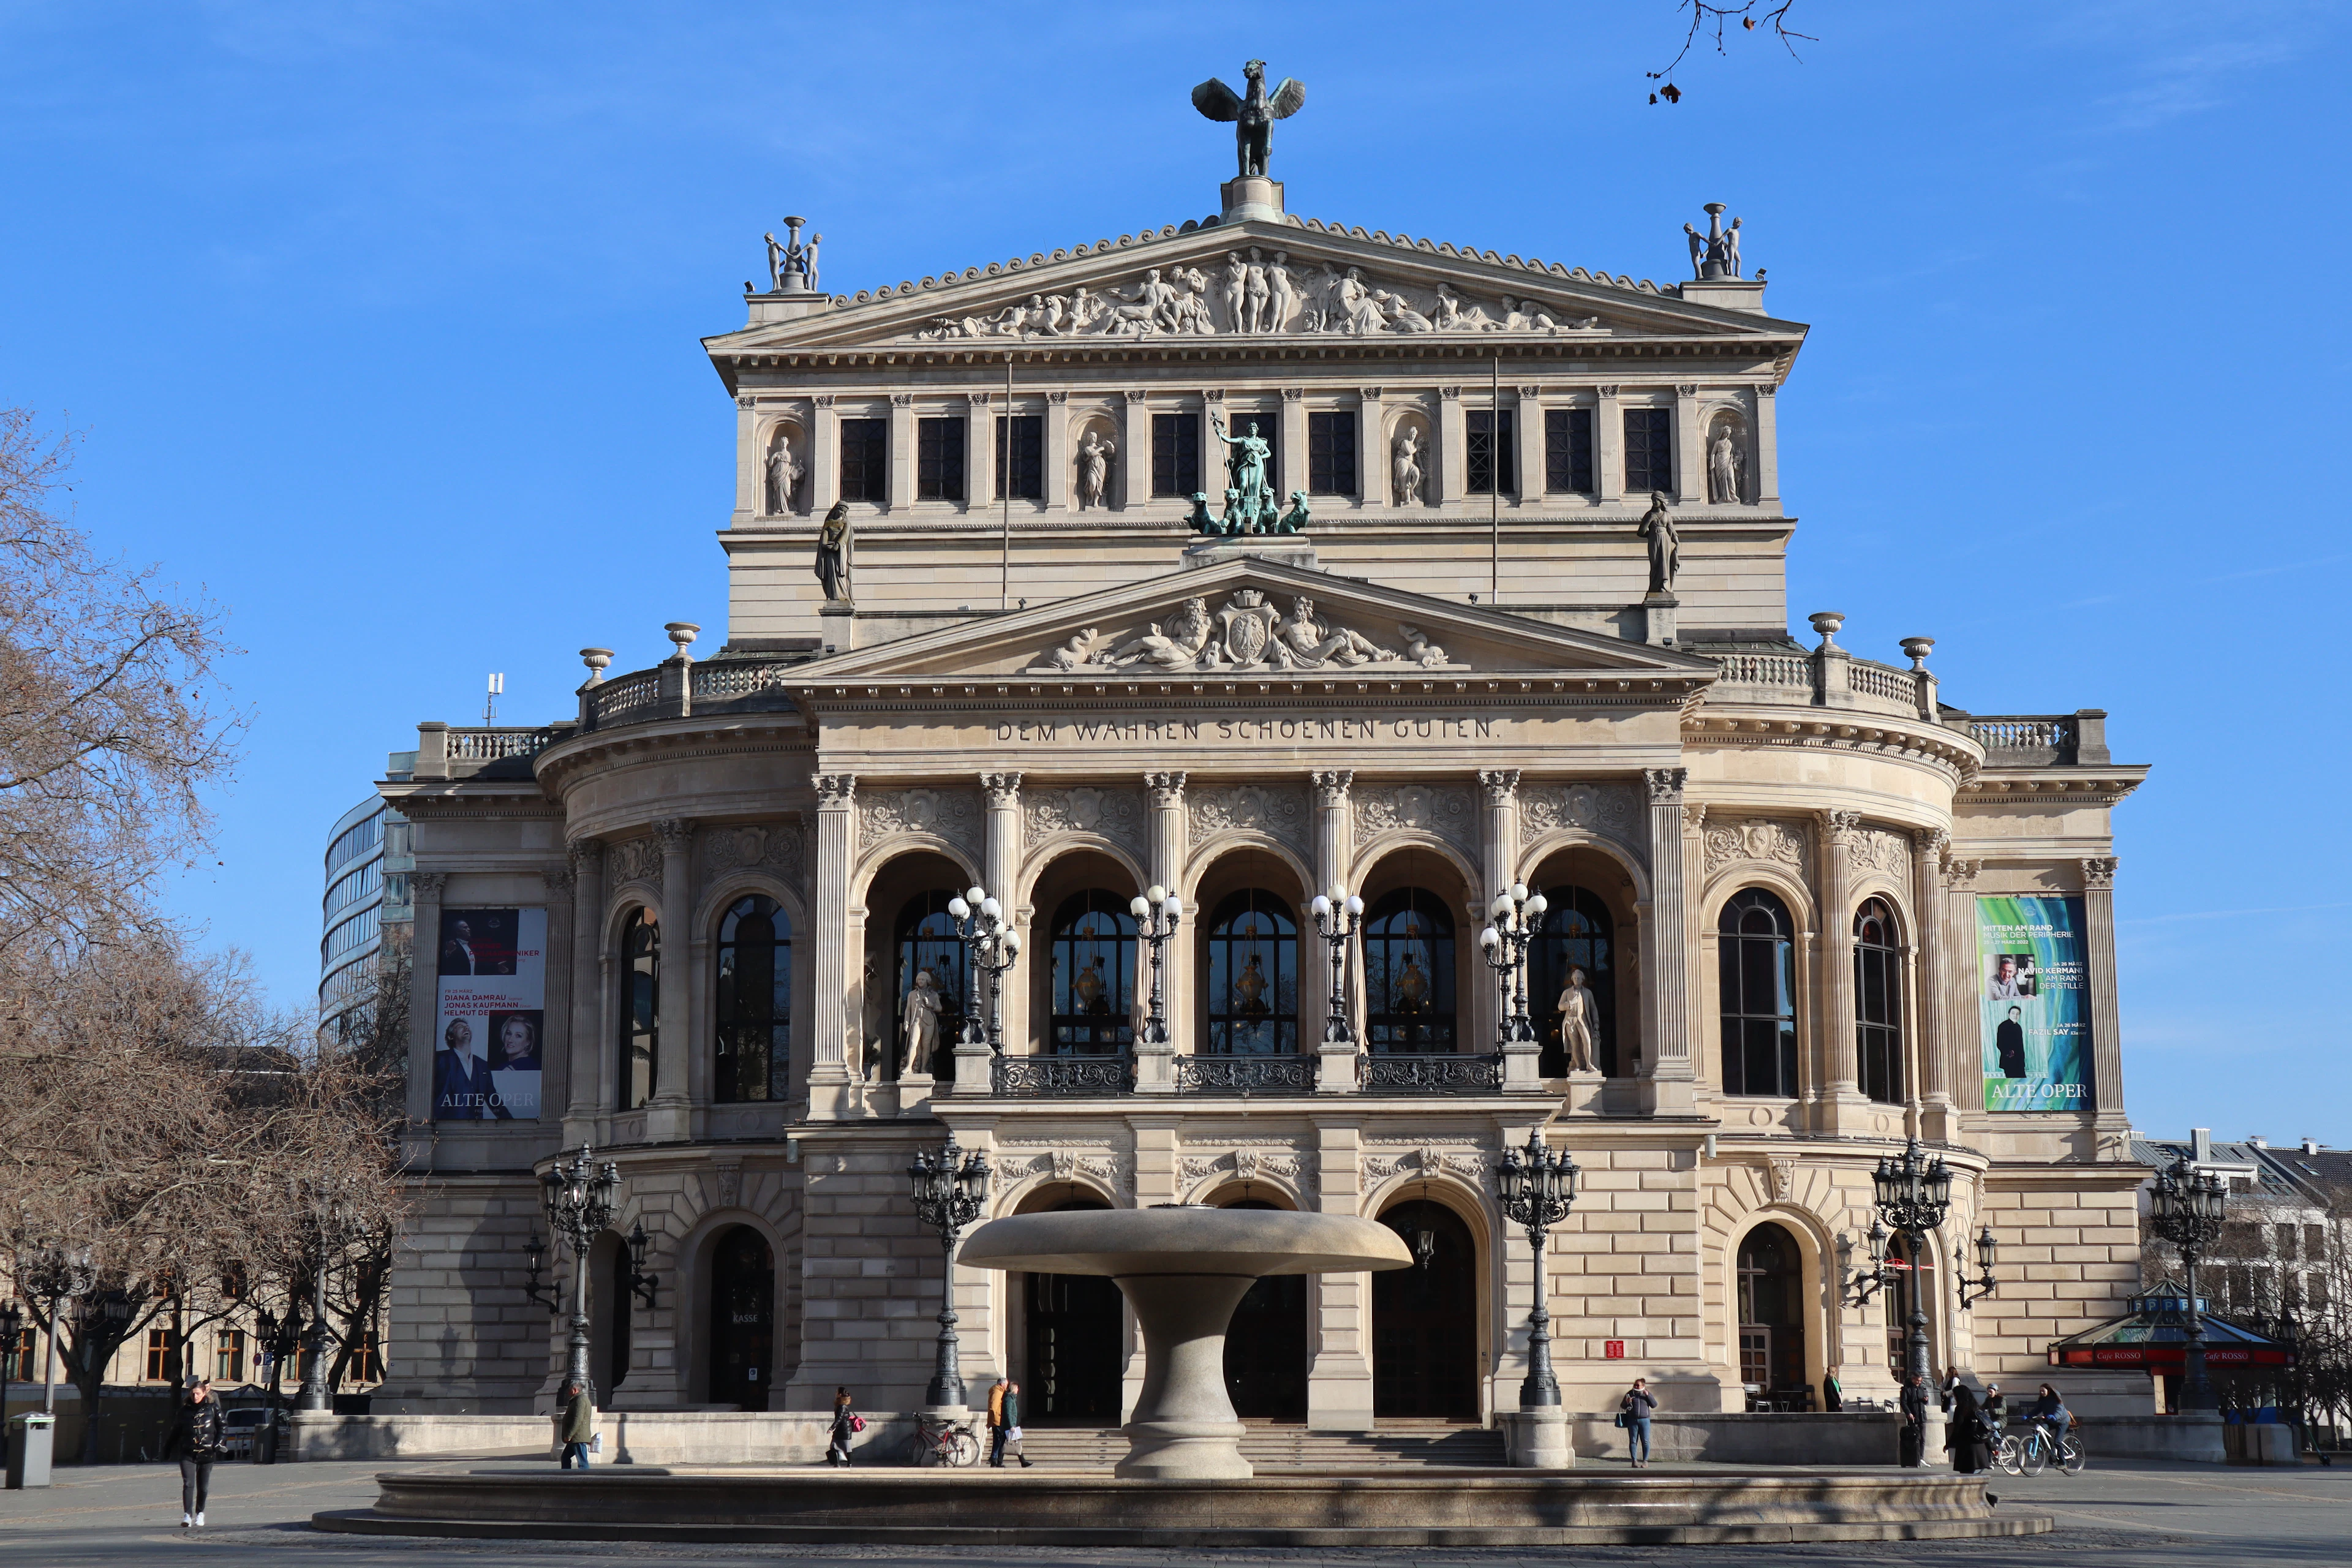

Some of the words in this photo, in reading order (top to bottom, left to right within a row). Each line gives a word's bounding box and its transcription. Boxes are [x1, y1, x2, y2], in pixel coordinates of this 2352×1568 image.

[997, 720, 1056, 742] DEM
[1072, 718, 1199, 741] WAHREN
[1216, 717, 1375, 740] SCHOENEN
[1392, 717, 1501, 739] GUTEN.
[1991, 1084, 2037, 1098] ALTE
[2041, 1084, 2088, 1098] OPER
[440, 1093, 484, 1107] ALTE
[489, 1093, 534, 1107] OPER
